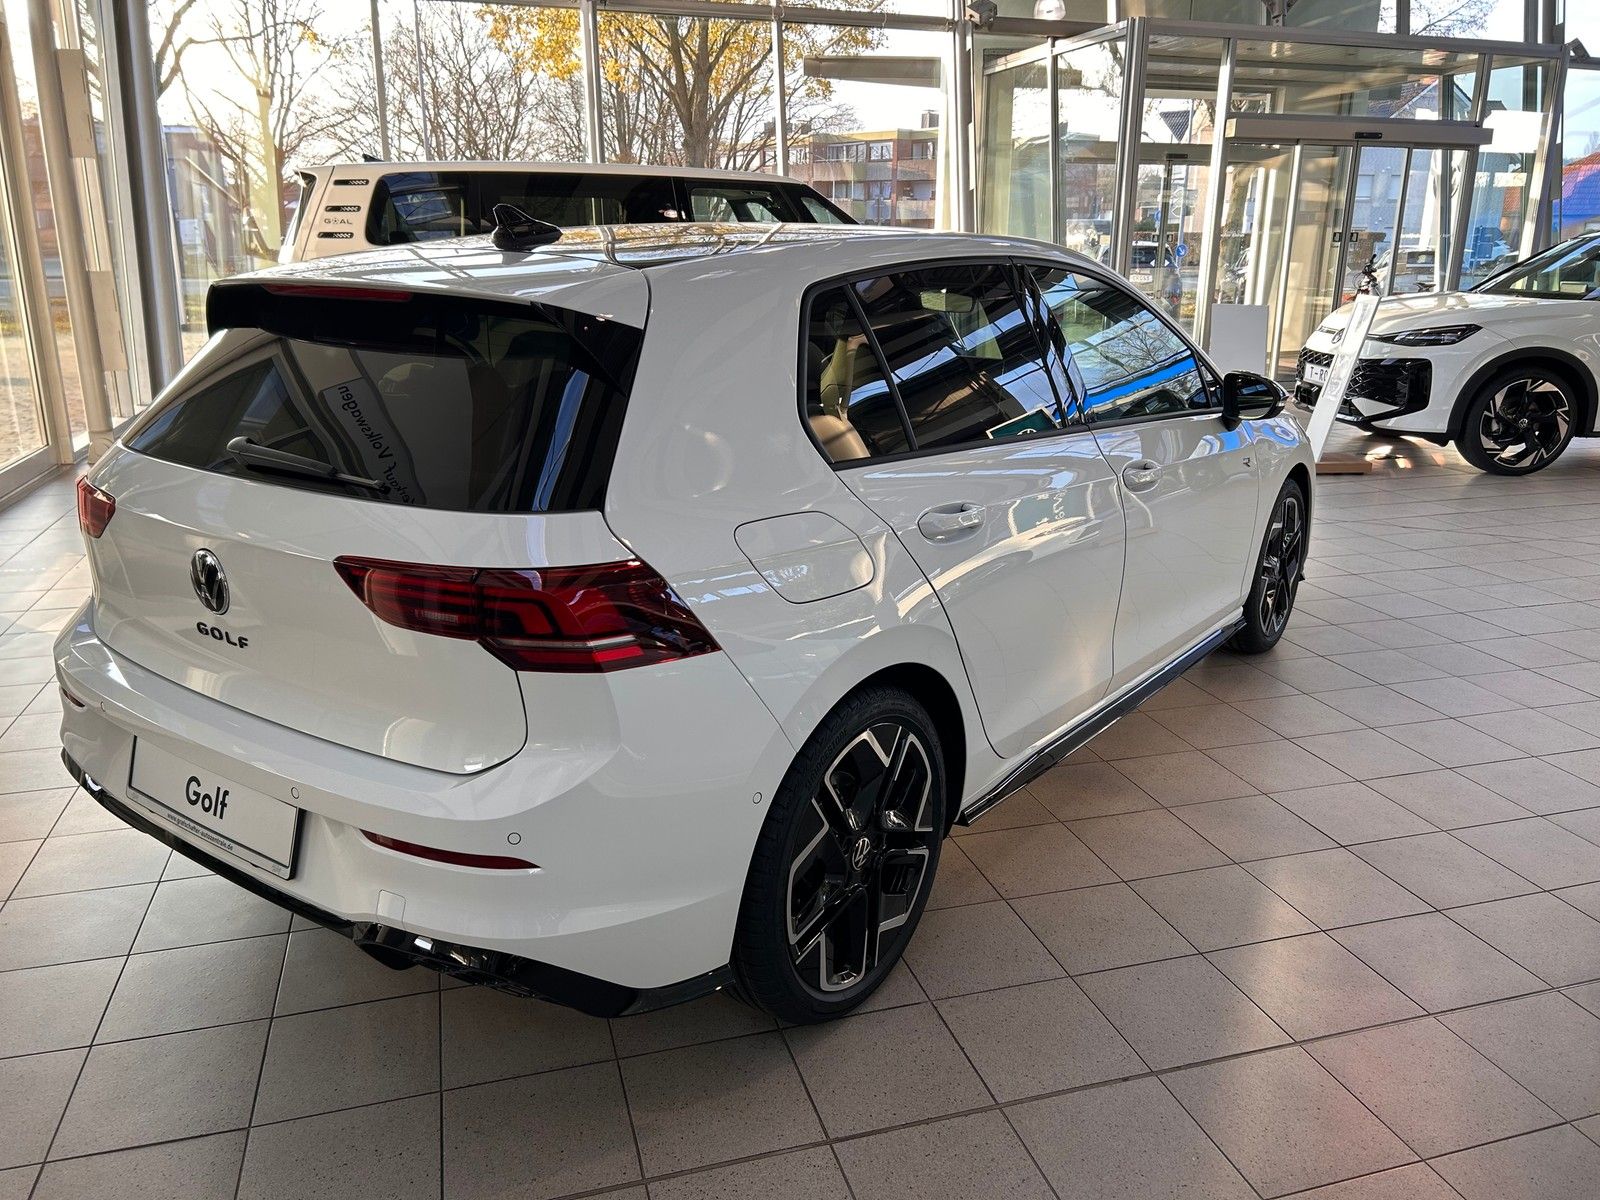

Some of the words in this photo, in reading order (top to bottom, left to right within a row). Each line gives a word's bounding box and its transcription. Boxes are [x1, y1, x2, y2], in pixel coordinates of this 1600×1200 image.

[1310, 366, 1329, 382] T-RO
[196, 621, 249, 648] GOLF
[185, 775, 230, 820] Golf
